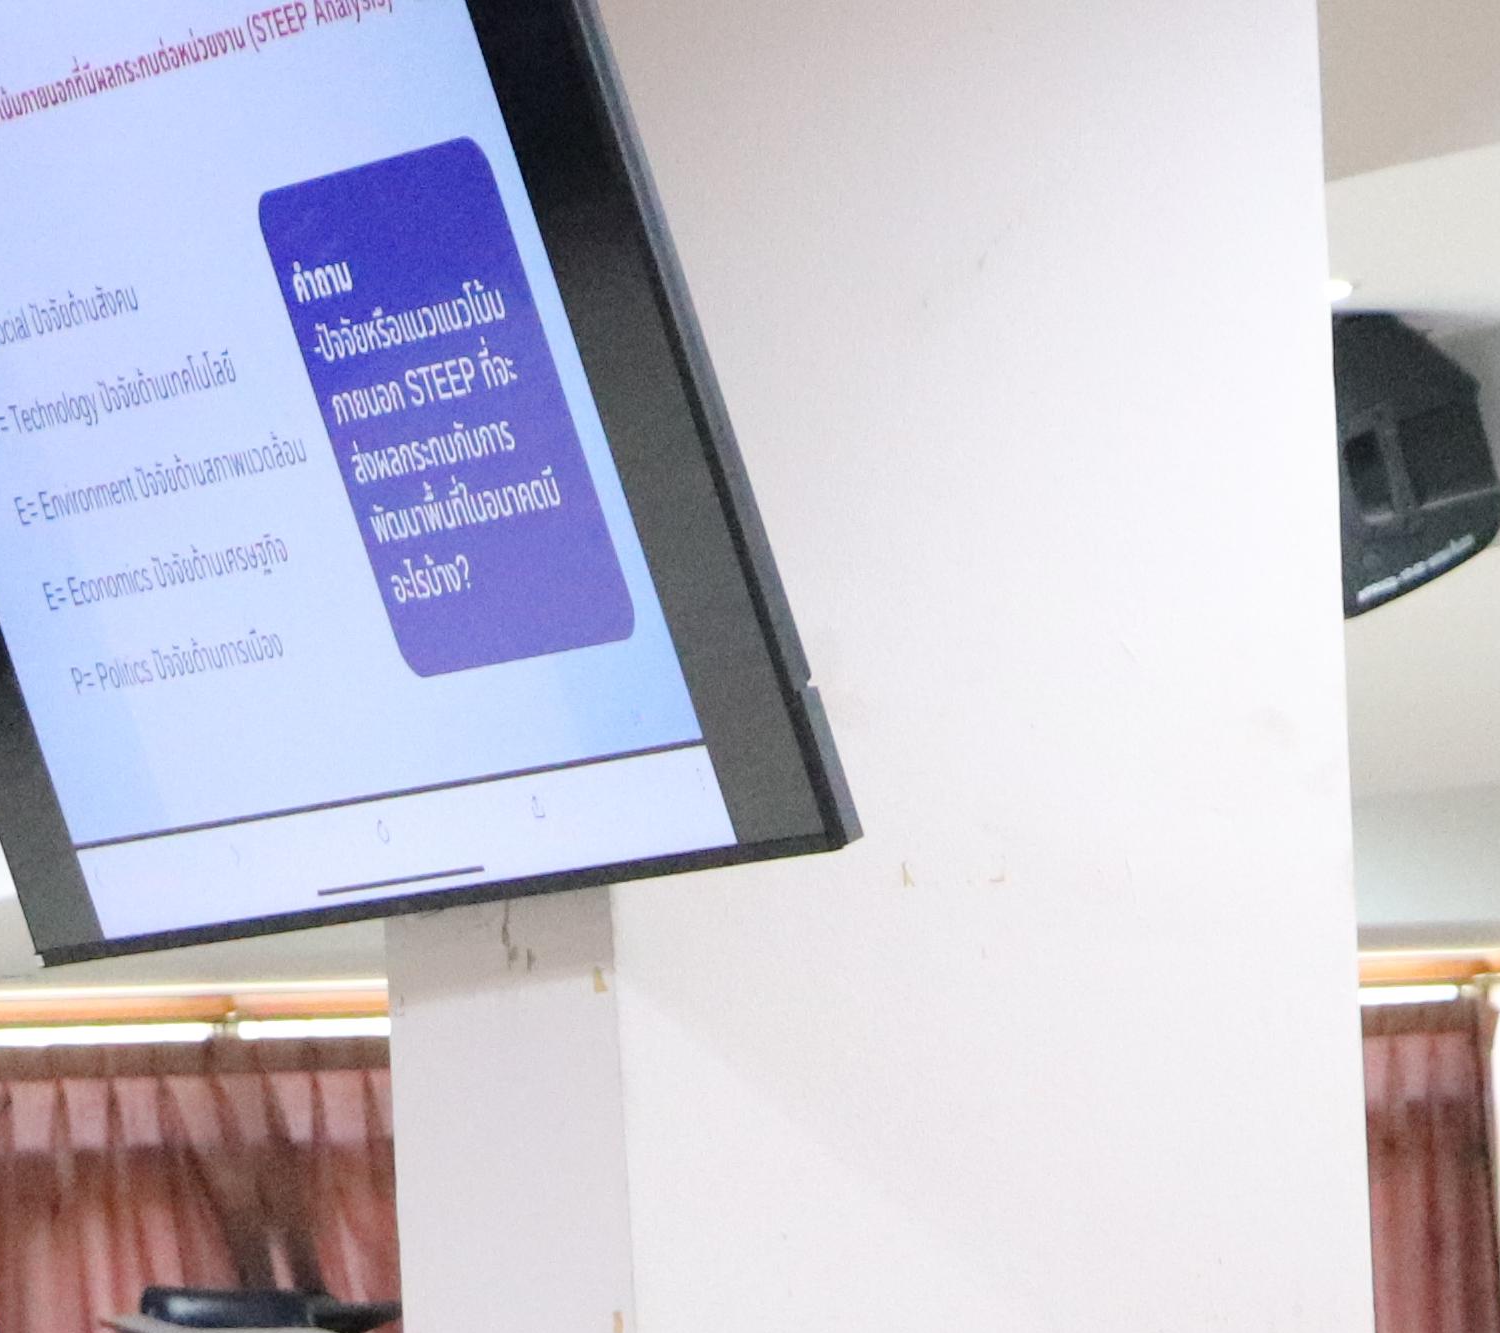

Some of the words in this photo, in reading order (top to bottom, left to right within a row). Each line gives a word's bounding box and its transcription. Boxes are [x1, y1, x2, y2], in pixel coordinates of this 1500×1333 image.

[246, 2, 307, 52] (STEEP
[292, 260, 353, 303] คำถาม
[30, 285, 139, 336] ปัจจัยด้านสังคม
[332, 380, 406, 425] ภายนอก
[404, 356, 475, 407] STEEP
[478, 336, 518, 390] ที่จะ
[8, 389, 99, 434] Technology
[351, 420, 516, 484] ส่งผลกระทบกับการ
[38, 475, 137, 521] Environment
[370, 464, 561, 544] พัฒนาพื้นที่ในอนาคตมี
[66, 563, 154, 606] Economics
[390, 554, 471, 603] อะไรบ้าง?
[95, 658, 154, 691] Politics
[153, 629, 284, 680] ปัจจัยด้านการเมือง
